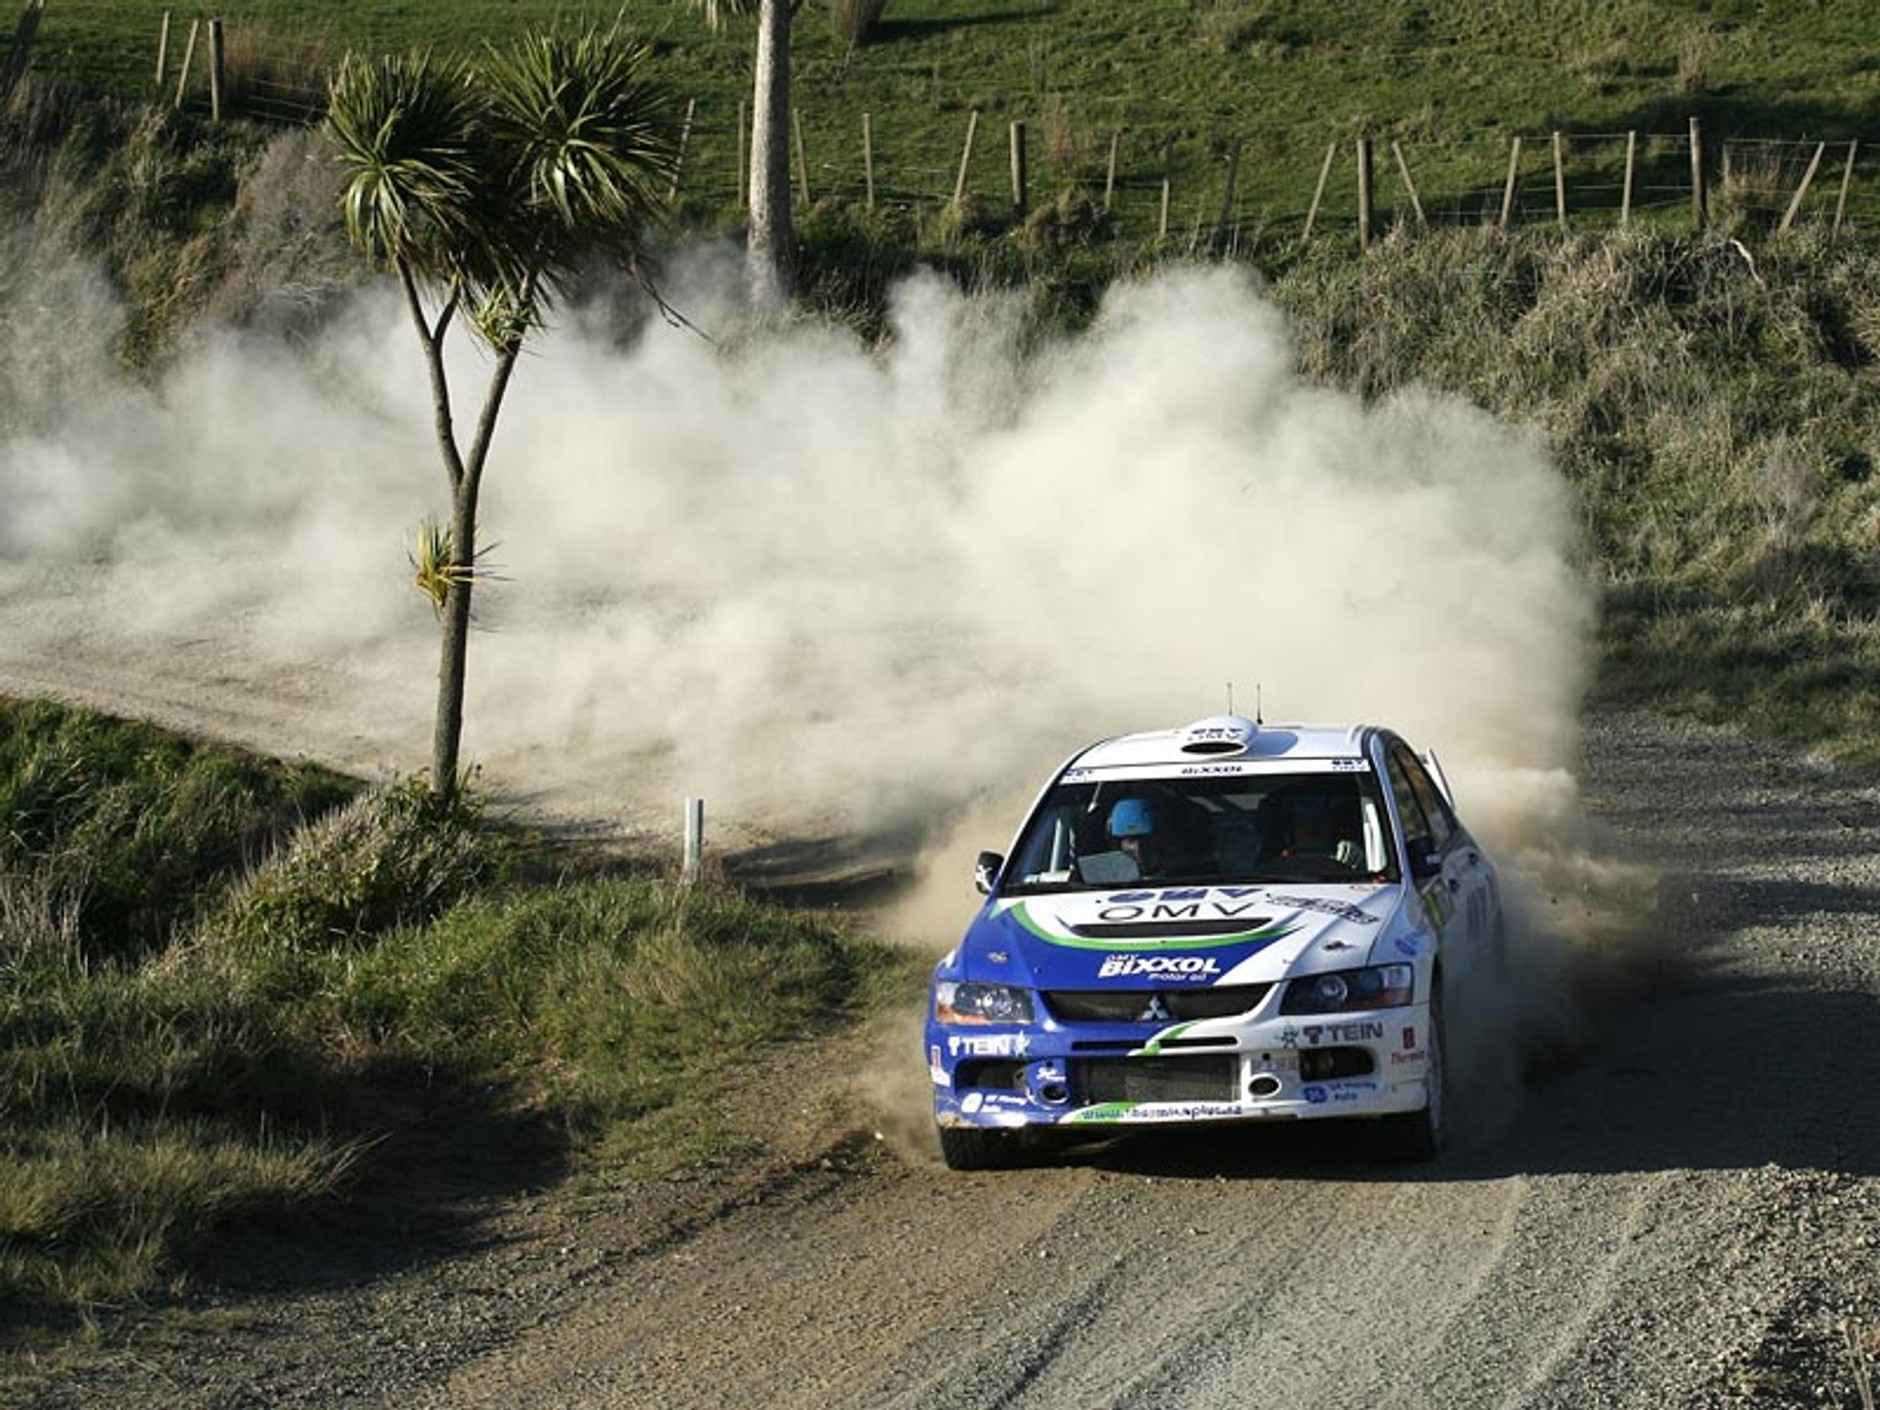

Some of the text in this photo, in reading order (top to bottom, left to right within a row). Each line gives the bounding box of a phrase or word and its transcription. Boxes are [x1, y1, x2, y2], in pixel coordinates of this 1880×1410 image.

[1098, 902, 1256, 921] OMV
[1147, 973, 1187, 981] motor
[1326, 1022, 1383, 1043] TEIN
[962, 1034, 1011, 1055] TEIN
